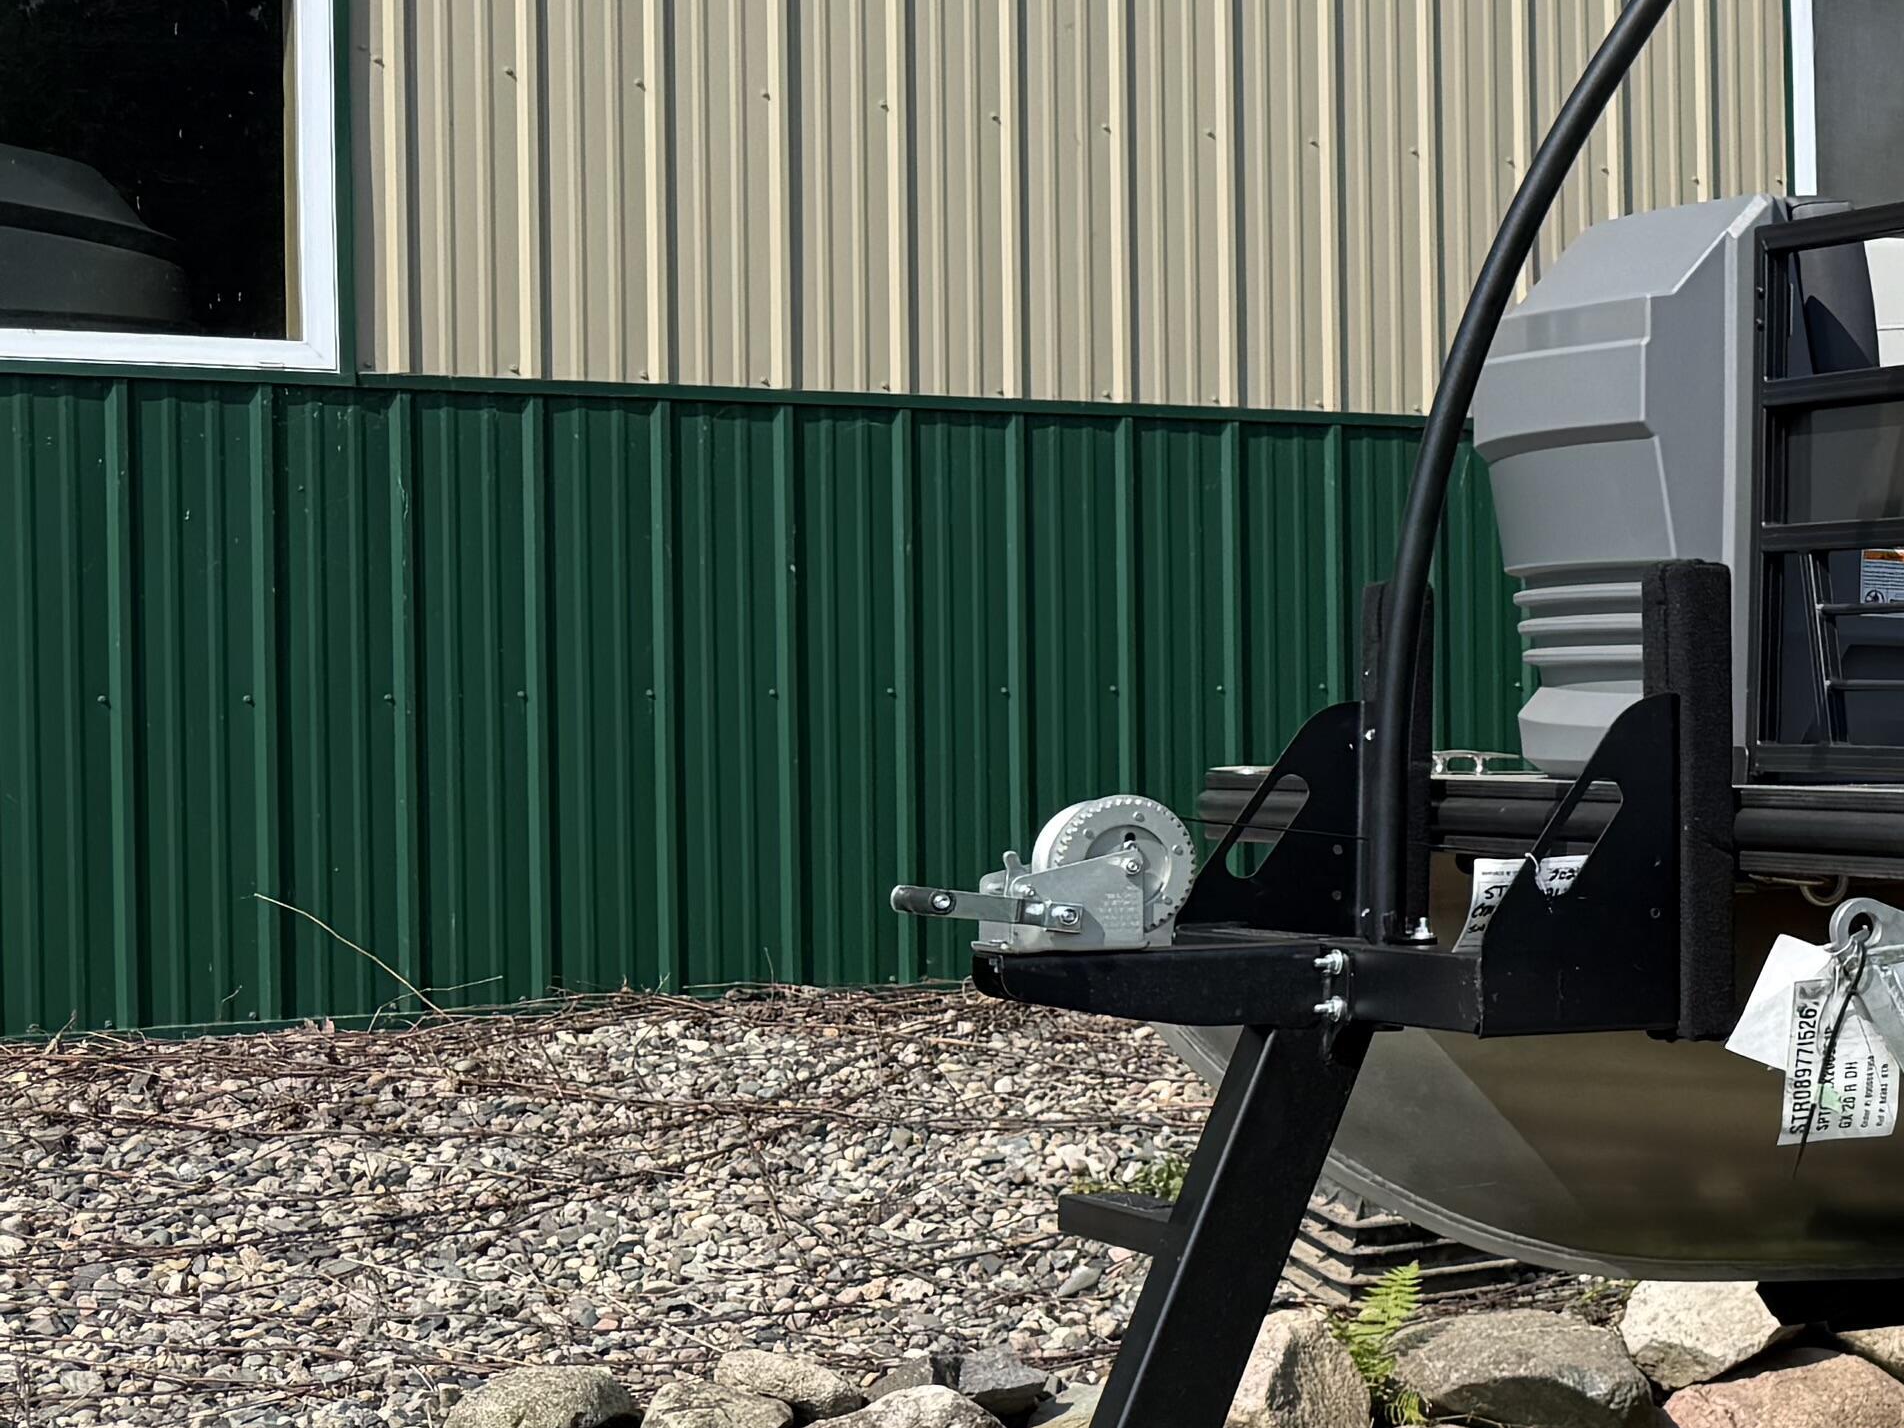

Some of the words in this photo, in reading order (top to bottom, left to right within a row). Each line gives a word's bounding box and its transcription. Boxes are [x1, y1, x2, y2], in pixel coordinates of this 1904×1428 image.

[1844, 1061, 1858, 1079] DH
[1841, 1096, 1856, 1114] 20
[1838, 1114, 1854, 1129] GX
